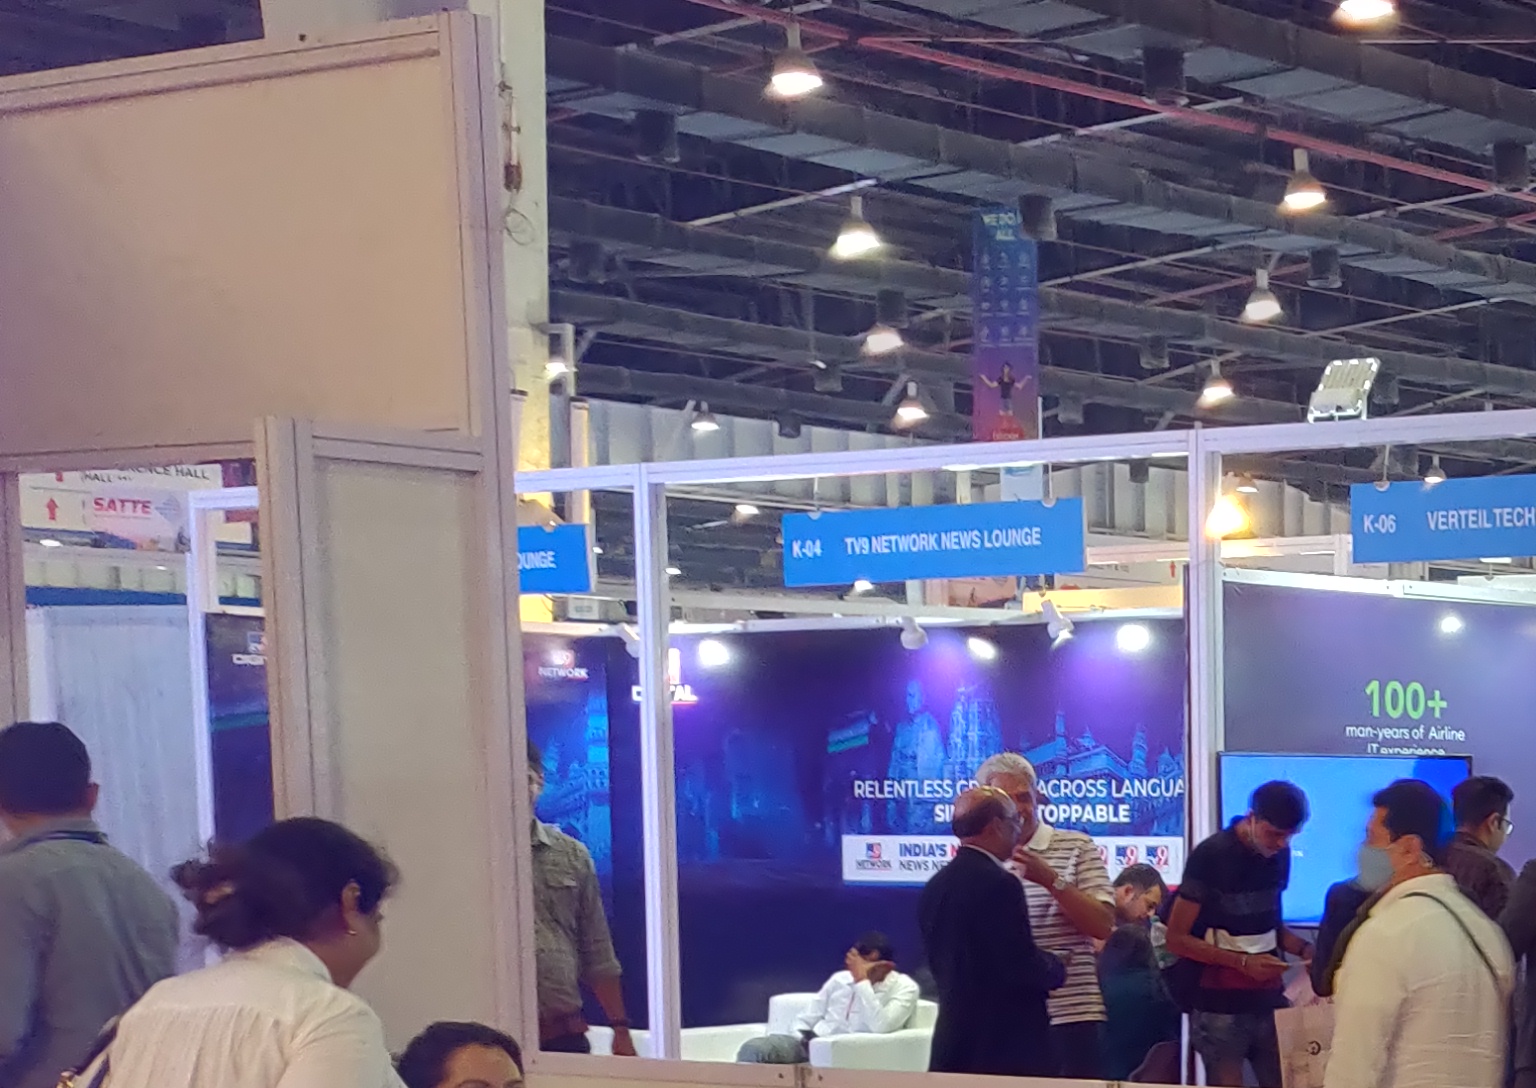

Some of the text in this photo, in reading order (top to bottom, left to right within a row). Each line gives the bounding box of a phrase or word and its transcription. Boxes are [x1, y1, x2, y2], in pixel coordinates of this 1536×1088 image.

[93, 498, 151, 514] SATTE
[1363, 514, 1396, 533] K-06
[1426, 510, 1492, 532] VERTEIL
[792, 526, 1042, 559] K-04 TV9 NETWORK NEWS LOUNGE
[1365, 680, 1447, 719] 100+
[1346, 725, 1465, 740] man-years of Airline
[1367, 743, 1379, 753] IT
[854, 779, 953, 798] RELENTLESS
[1037, 778, 1108, 798] ACROSS
[899, 843, 947, 857] INDIA'S
[898, 861, 930, 872] NEWS
